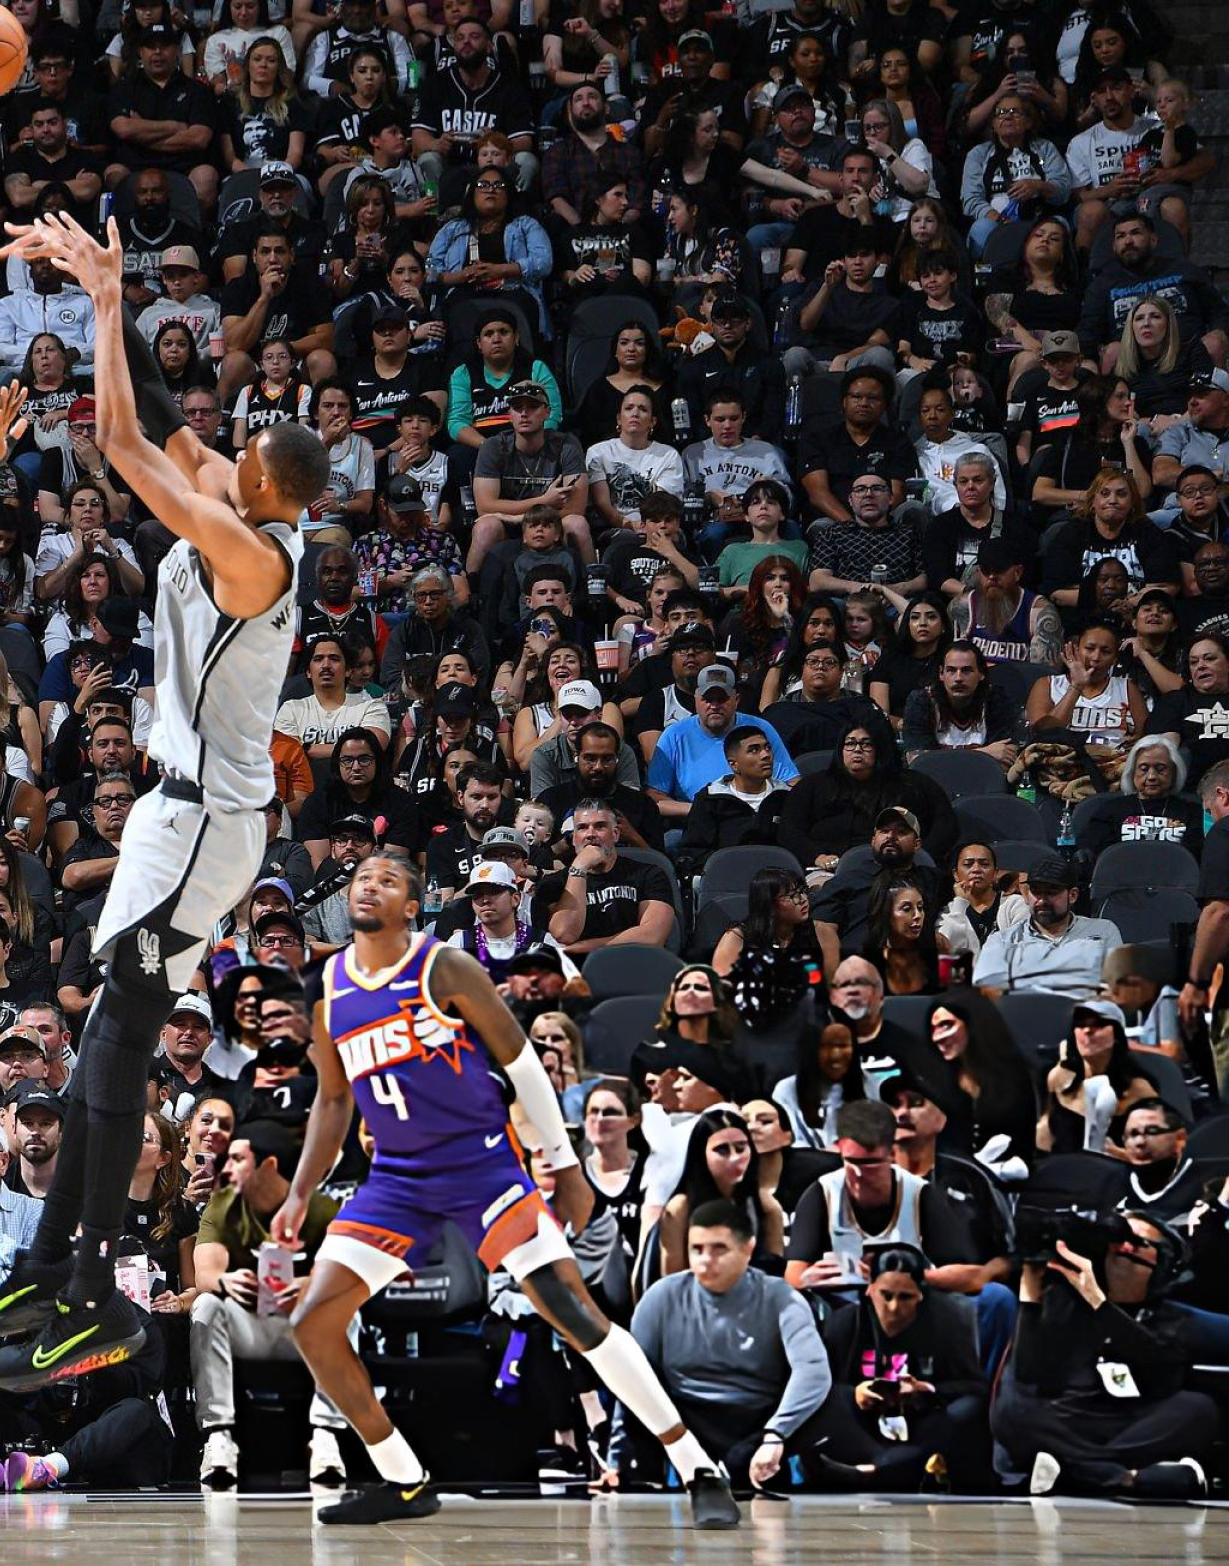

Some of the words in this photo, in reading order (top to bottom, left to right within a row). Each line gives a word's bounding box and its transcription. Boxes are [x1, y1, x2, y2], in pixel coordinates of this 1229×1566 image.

[441, 109, 496, 133] CASTLE
[1071, 709, 1123, 729] UNS
[1140, 815, 1168, 830] GO
[595, 885, 638, 904] ANTONIO
[338, 1018, 413, 1082] UNS
[369, 1073, 410, 1121] 4
